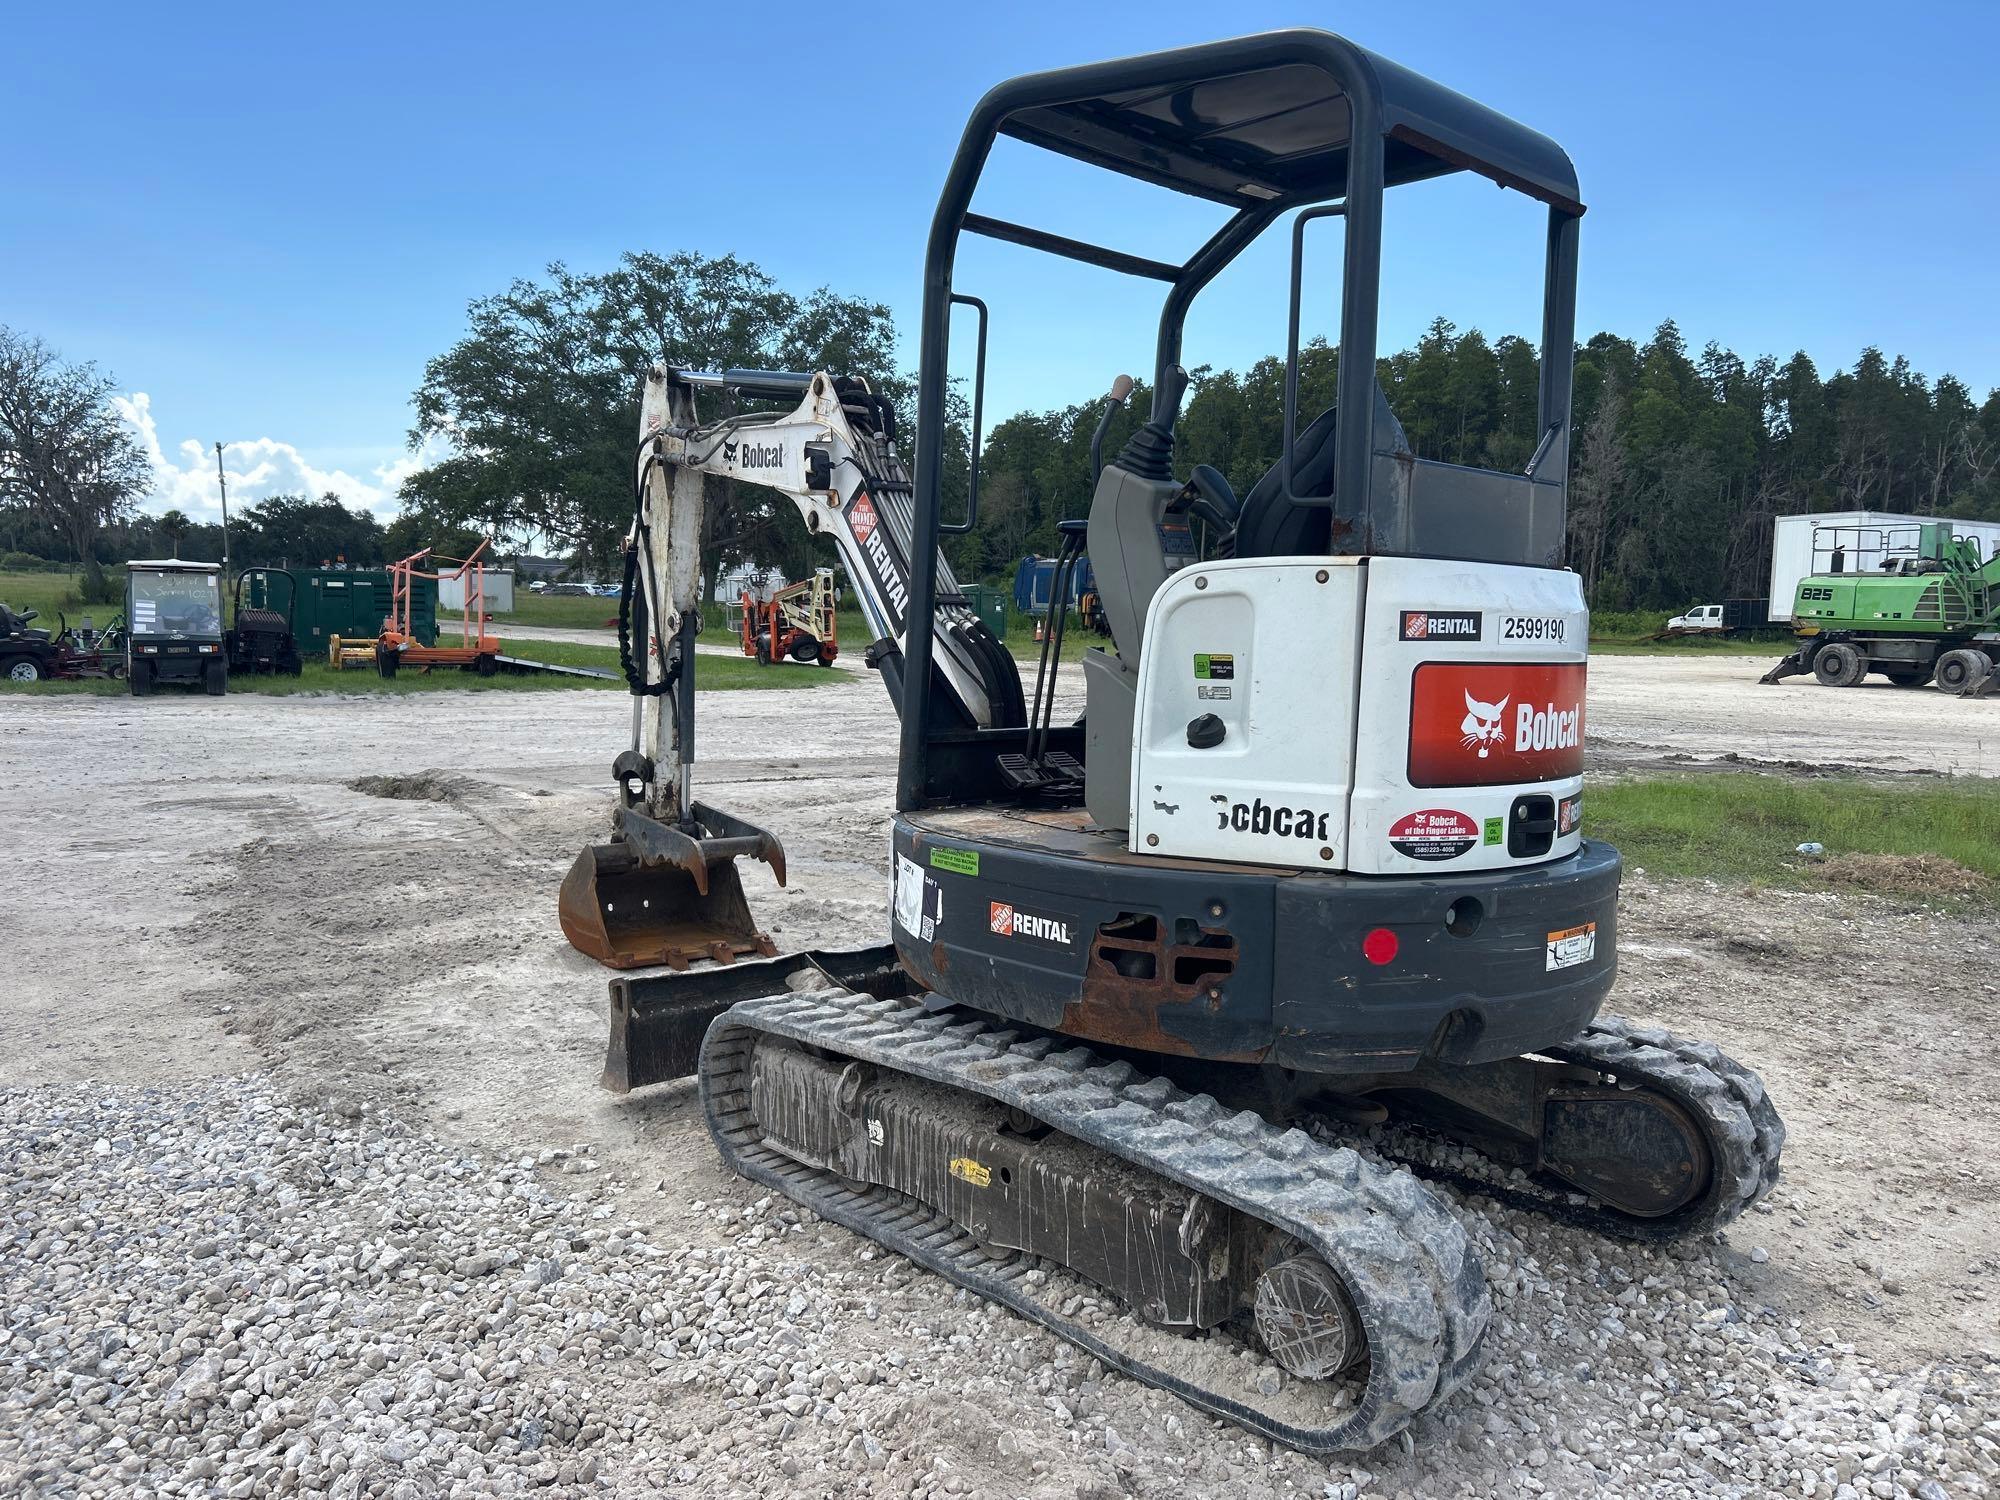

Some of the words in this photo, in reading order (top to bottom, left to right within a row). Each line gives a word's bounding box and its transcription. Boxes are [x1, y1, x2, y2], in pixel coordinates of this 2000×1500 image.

[742, 443, 783, 468] Bobcat
[851, 512, 876, 525] HOME
[854, 525, 871, 533] DEPOT
[865, 528, 909, 621] RENTAL
[1801, 587, 1834, 601] 825
[1406, 614, 1428, 637] HOME
[1428, 618, 1477, 634] RENTAL
[1504, 618, 1564, 639] 2599190
[1515, 703, 1579, 752] Bobcat
[1429, 816, 1457, 826] Bobcat
[1426, 827, 1447, 835] Finger
[925, 876, 934, 886] DAY
[991, 907, 1011, 930] HOME
[1013, 912, 1071, 945] RENTAL
